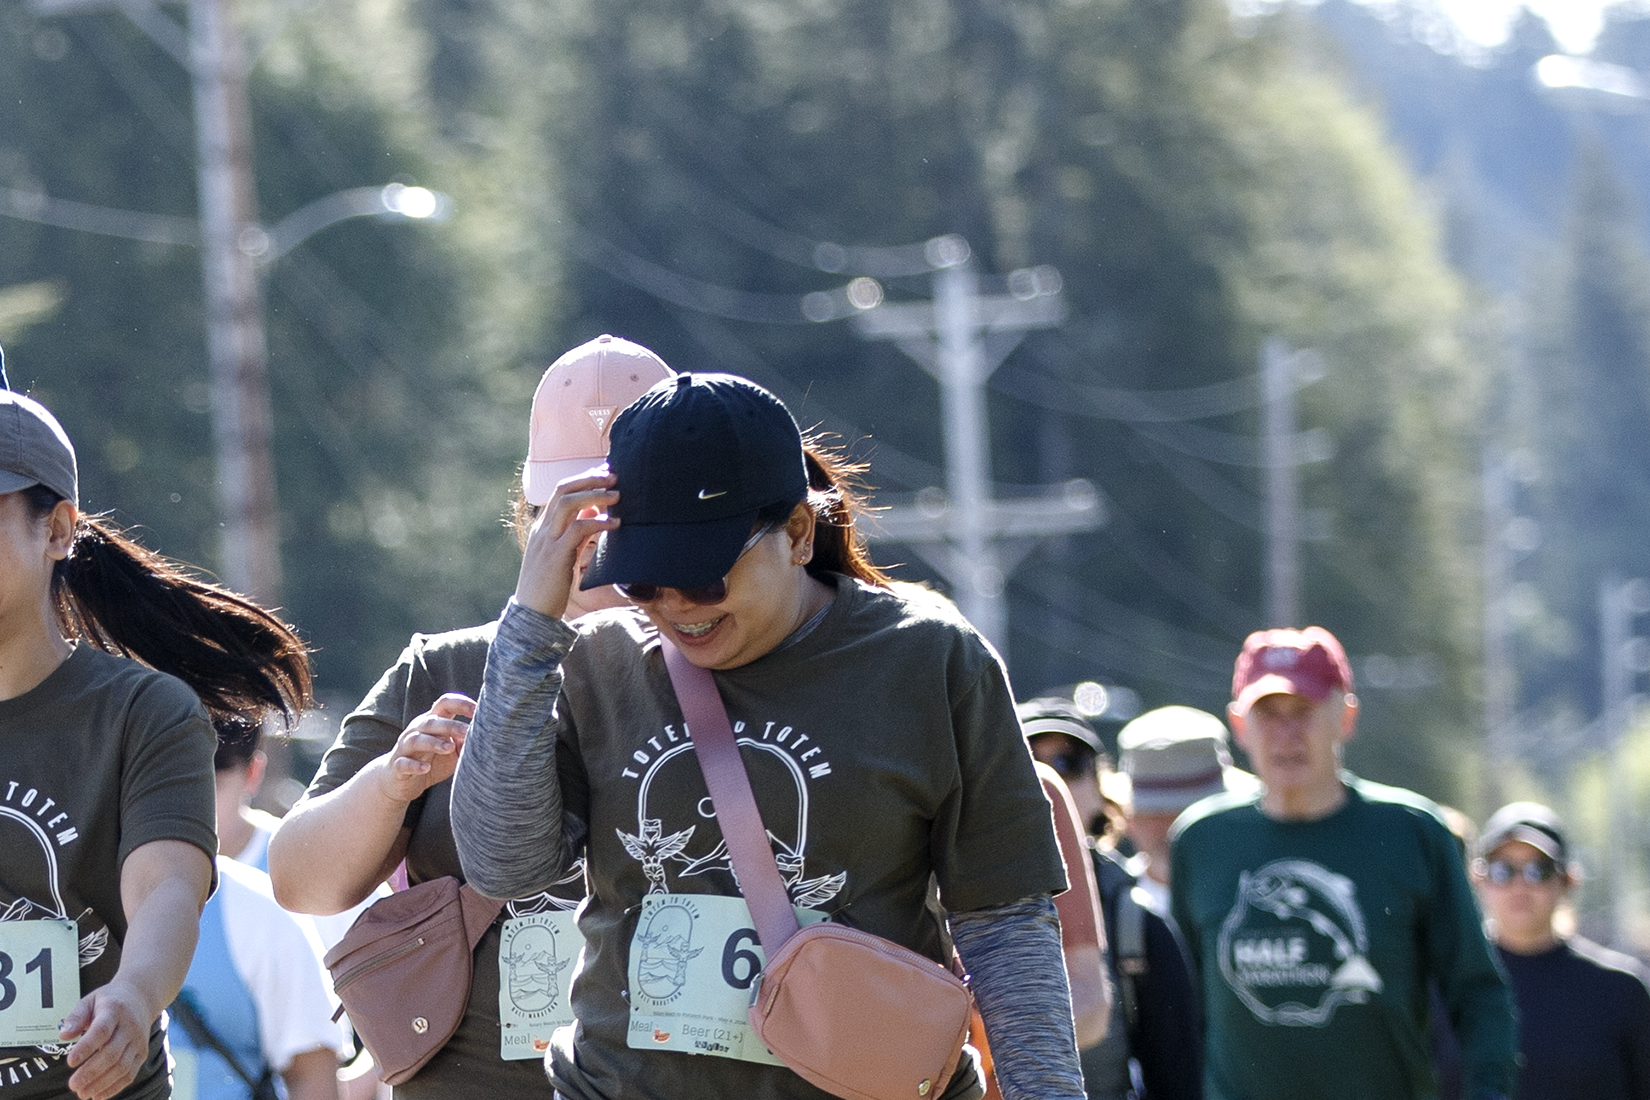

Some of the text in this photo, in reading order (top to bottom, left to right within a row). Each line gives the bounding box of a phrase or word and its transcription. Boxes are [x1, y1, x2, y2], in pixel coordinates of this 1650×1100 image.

[762, 721, 832, 779] TOTEM
[6, 780, 80, 847] TOTEM
[504, 1033, 531, 1046] Meal
[630, 1020, 744, 1043] Meal Beer (21+)
